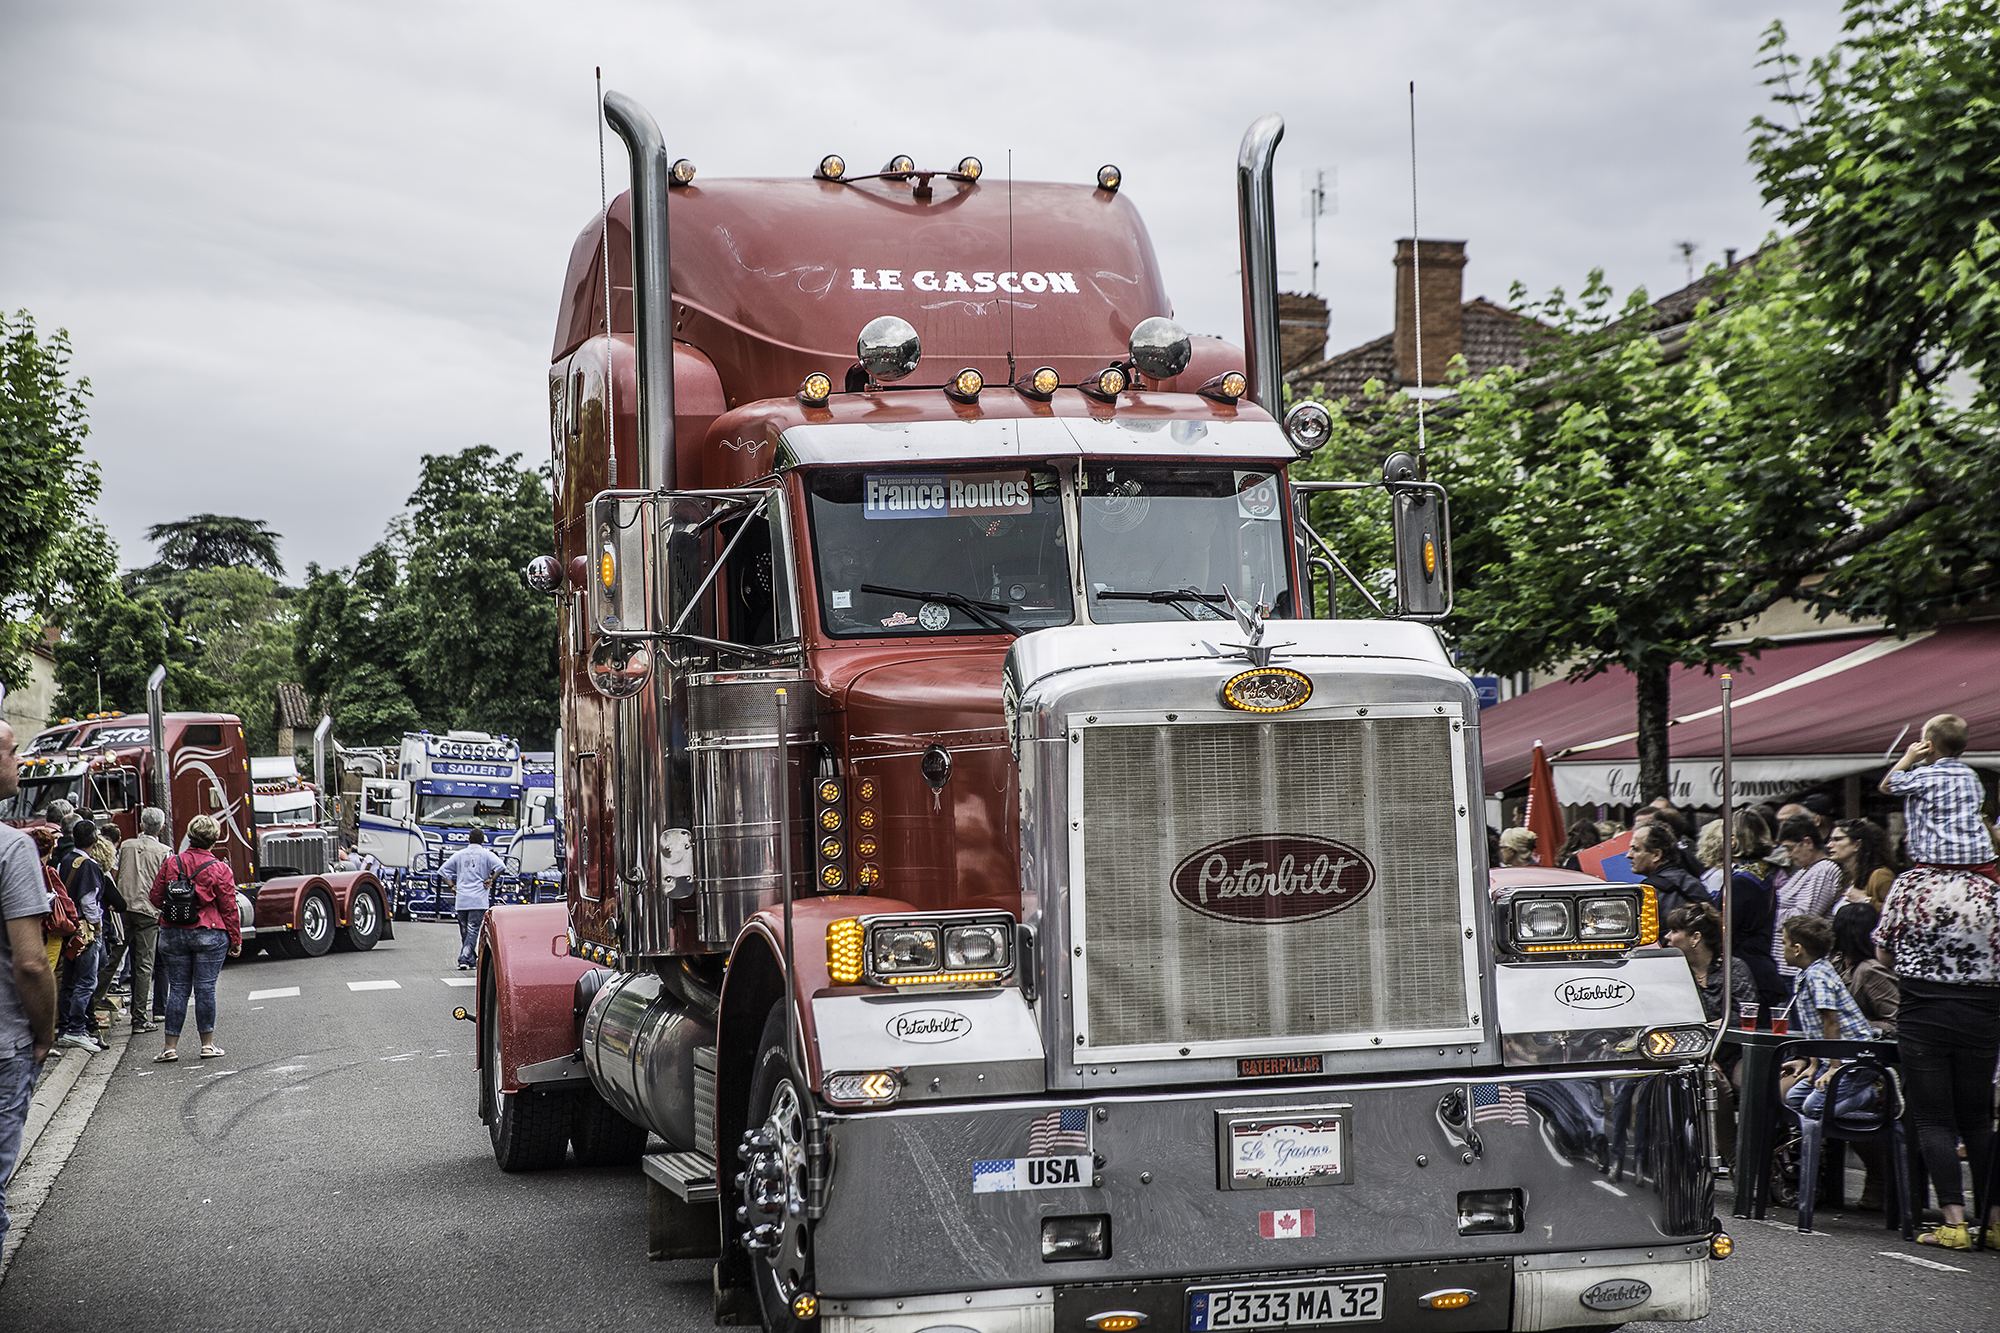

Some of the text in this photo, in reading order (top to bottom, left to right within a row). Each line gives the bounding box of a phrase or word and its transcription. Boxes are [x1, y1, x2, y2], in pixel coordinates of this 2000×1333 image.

[850, 268, 1080, 294] LE GASCON
[888, 478, 911, 486] passion
[867, 479, 1029, 511] France Routes
[1244, 486, 1270, 503] 20
[448, 764, 497, 776] SADLER
[1607, 767, 1643, 805] Caf
[1667, 769, 1695, 798] du
[447, 832, 490, 843] SCAA
[1198, 853, 1359, 904] Peterbilt
[1564, 984, 1627, 1003] Peterbilt
[896, 1016, 964, 1037] Peterbilt
[1241, 1057, 1320, 1075] CATERPILLAR
[1239, 1139, 1332, 1167] Le Gascon
[1028, 1158, 1081, 1185] USA
[1266, 1176, 1309, 1188] Peterbilt
[1589, 1284, 1646, 1305] Peterbilt
[1213, 1287, 1378, 1326] 2333 MA 32
[1195, 1315, 1203, 1326] F
